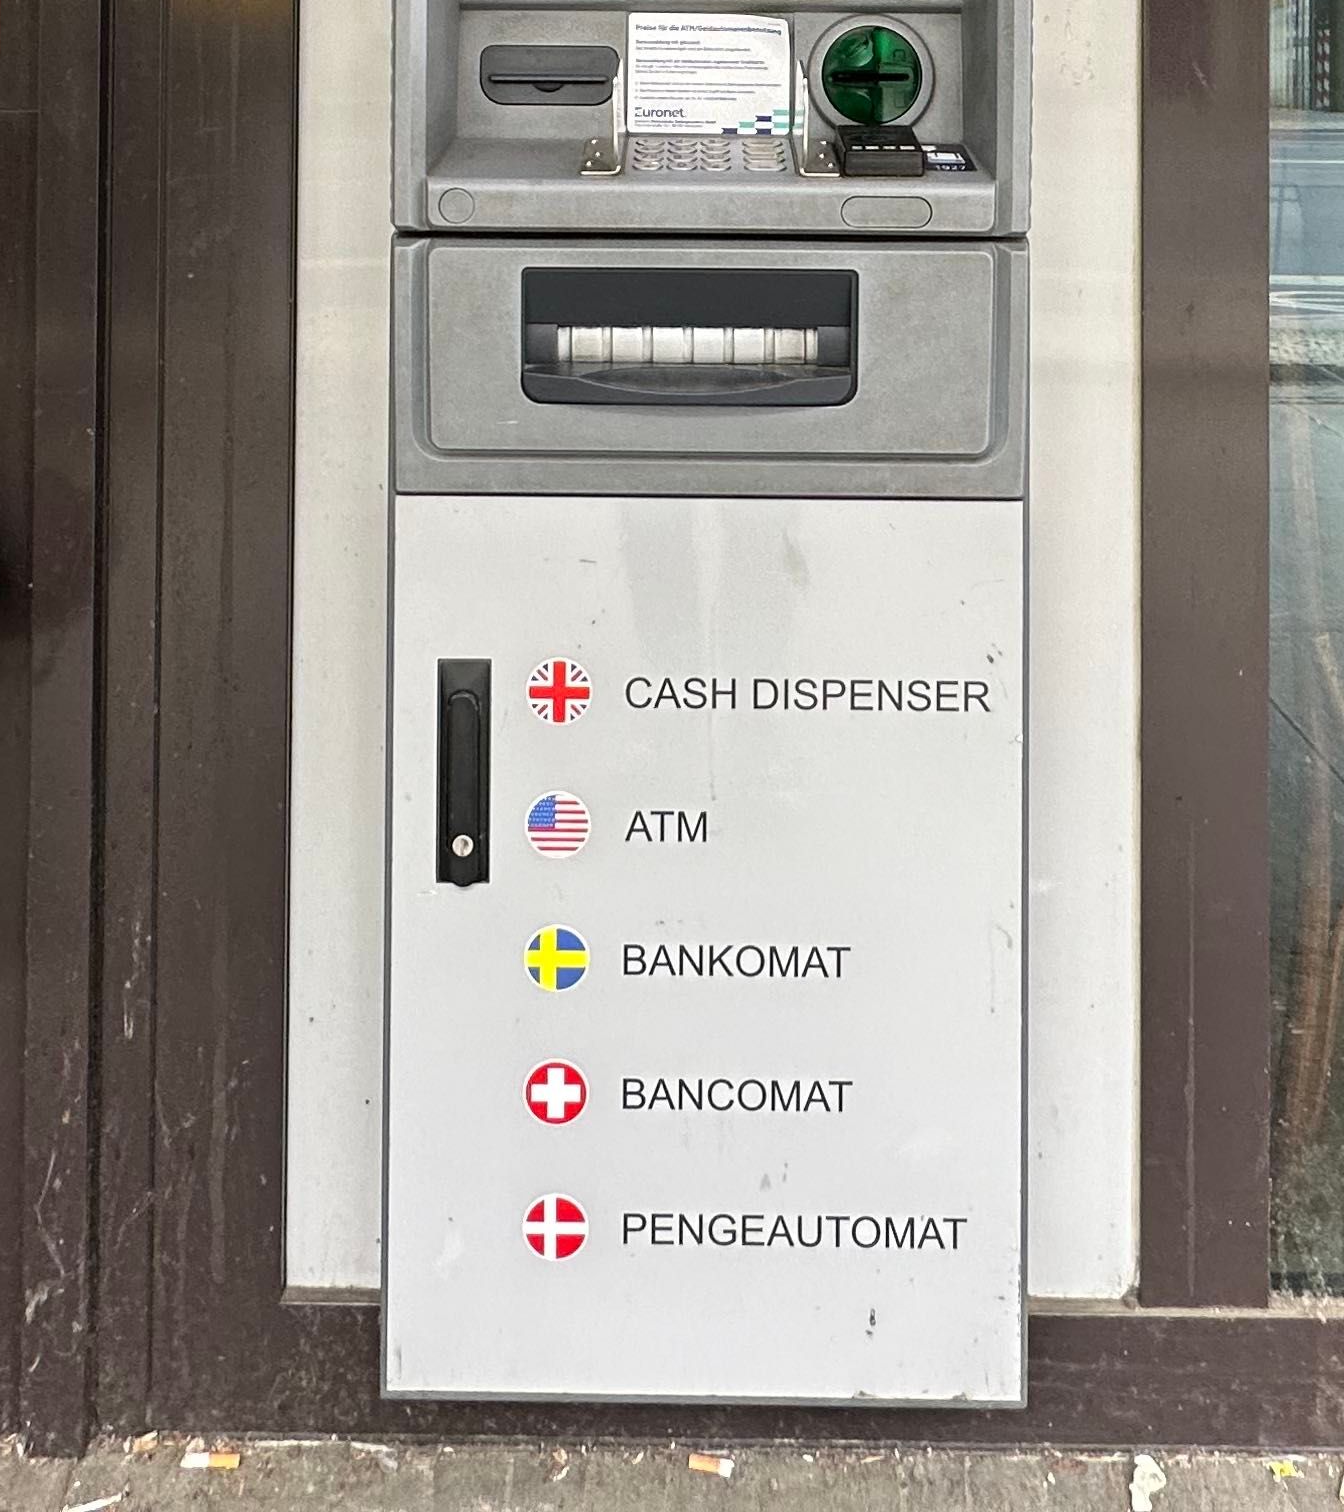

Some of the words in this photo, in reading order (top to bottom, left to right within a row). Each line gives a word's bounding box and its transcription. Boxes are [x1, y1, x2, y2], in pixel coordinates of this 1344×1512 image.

[625, 677, 737, 710] CASH
[752, 678, 992, 713] DISPENSER
[625, 811, 709, 843] ATM
[623, 944, 851, 979] BANKOMAT
[622, 1078, 853, 1113] BANCOMAT
[622, 1213, 967, 1251] PENGEAUTOMAT
